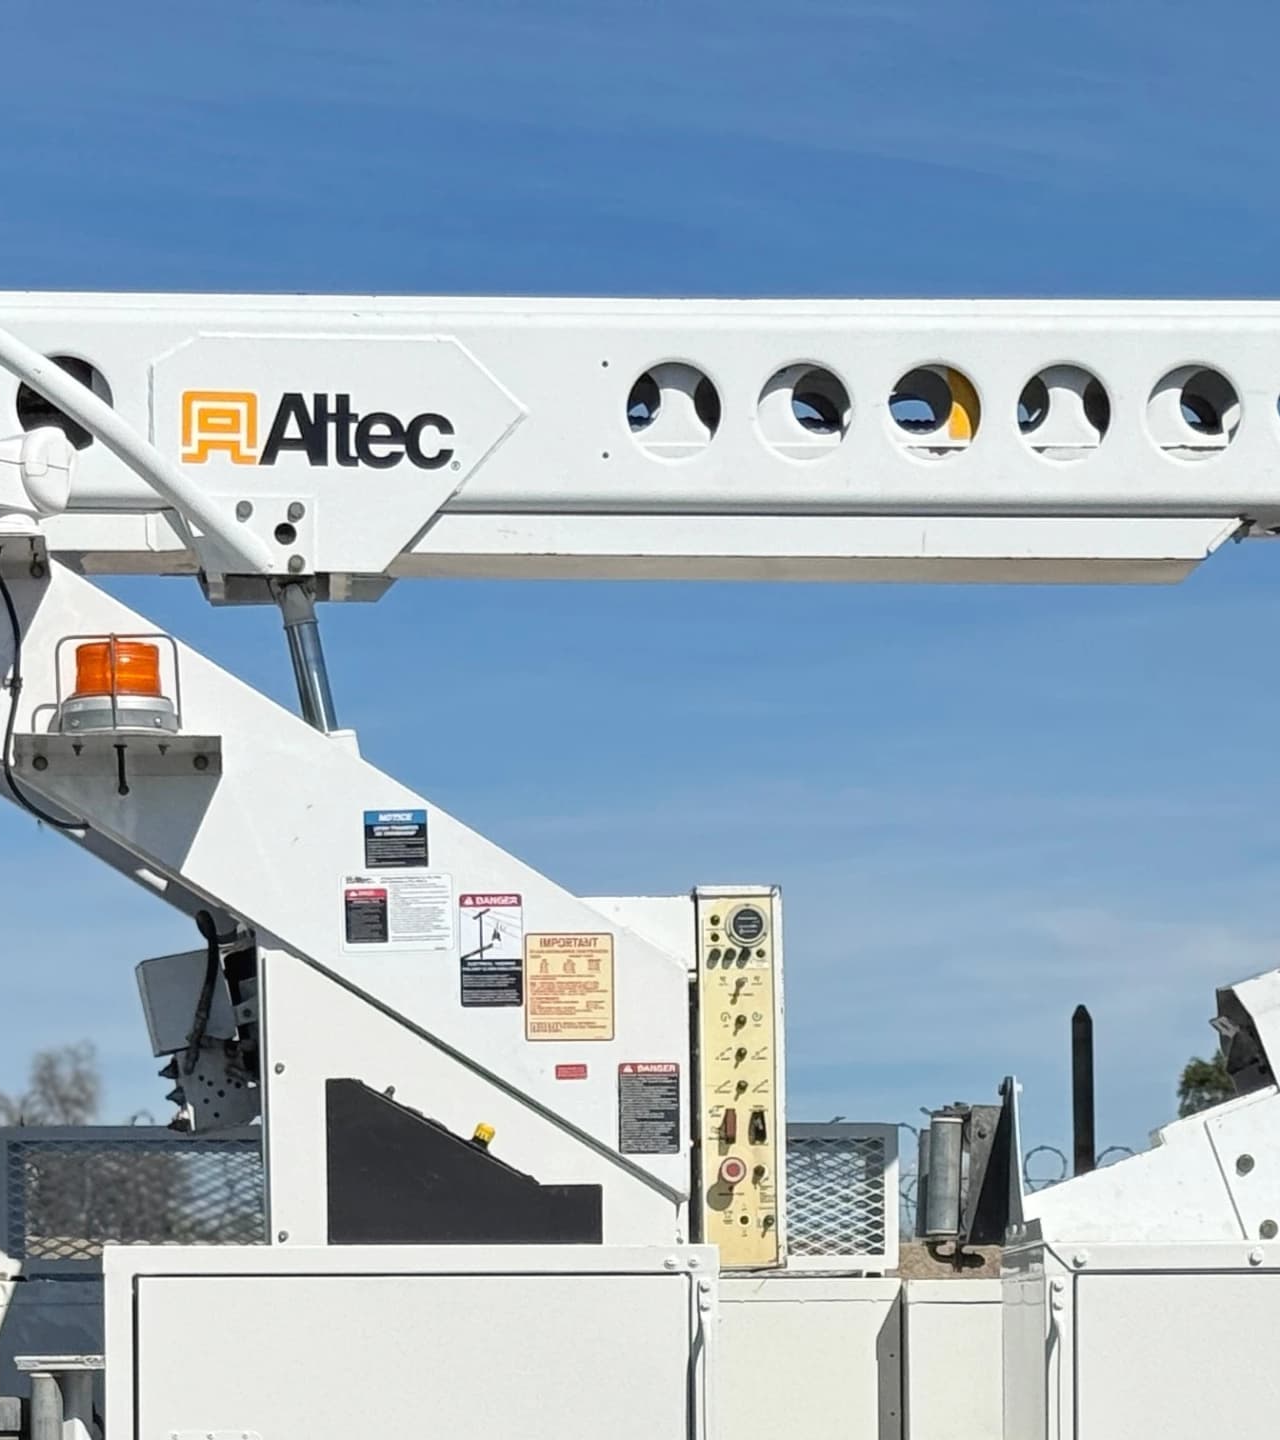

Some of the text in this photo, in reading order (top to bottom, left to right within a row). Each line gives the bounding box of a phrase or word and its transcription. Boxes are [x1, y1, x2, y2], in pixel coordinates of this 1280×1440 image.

[259, 392, 456, 469] Altec
[475, 896, 519, 906] DANGER
[539, 937, 599, 949] IMPORTANT
[637, 1064, 677, 1074] DANGER
